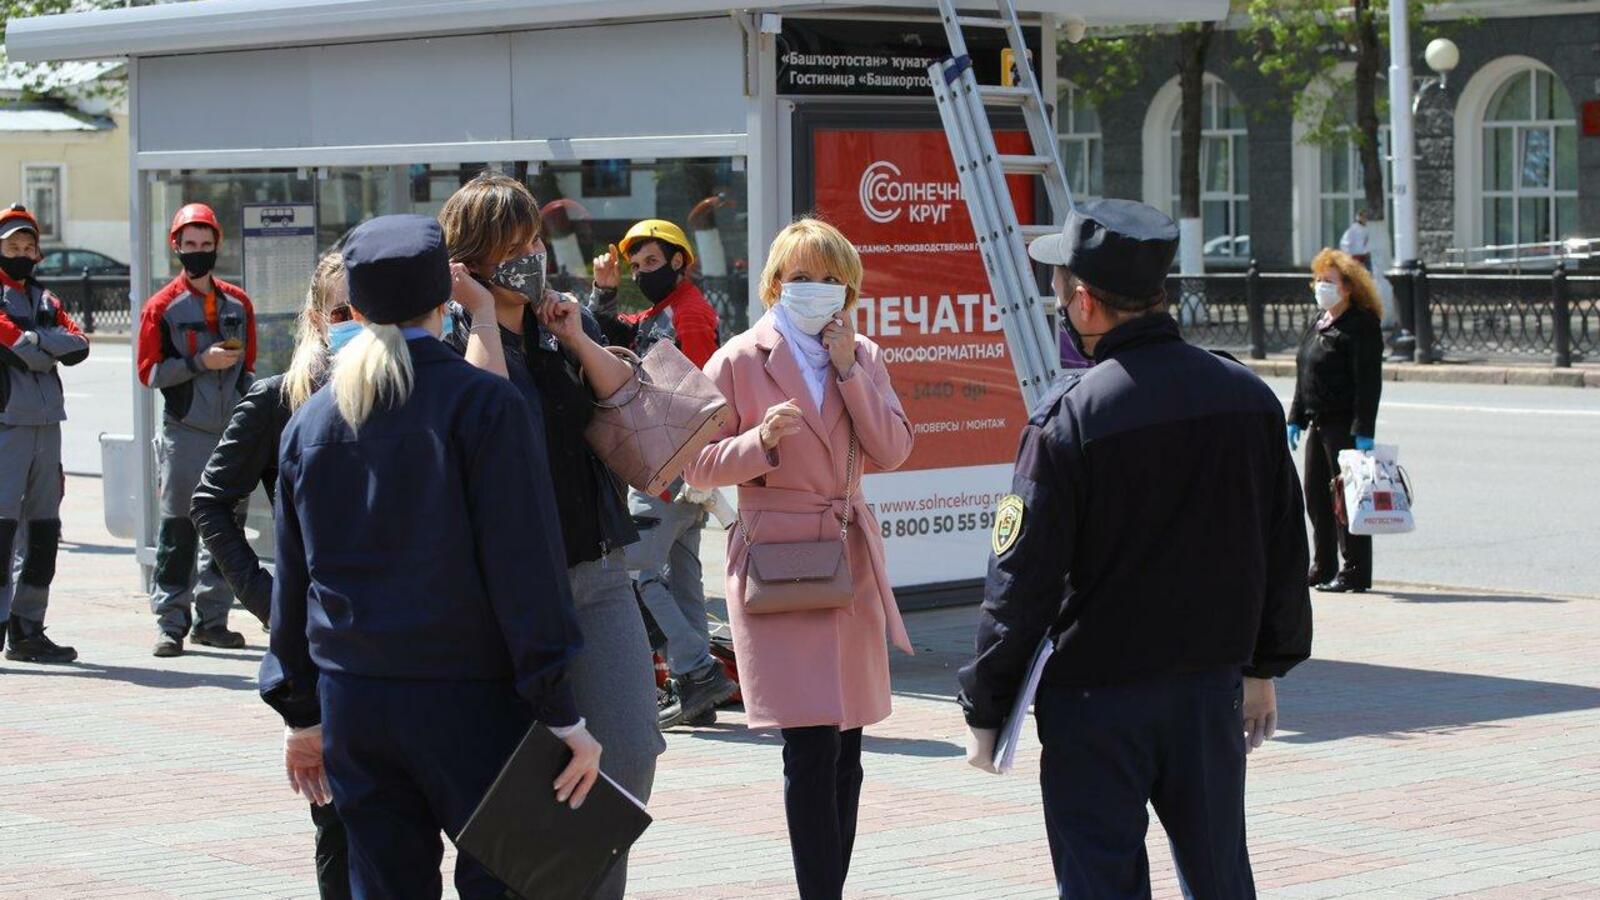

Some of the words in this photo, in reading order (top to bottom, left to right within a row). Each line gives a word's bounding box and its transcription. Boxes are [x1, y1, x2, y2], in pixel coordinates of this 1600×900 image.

[790, 70, 855, 87] Гостиница
[909, 203, 951, 224] КРУГ
[851, 294, 1003, 336] ПЕЧАТЬ
[880, 343, 1005, 364] ОКОФОРМАТНАЯ
[914, 421, 960, 434] ЛЮВЕРСЫ
[966, 418, 1006, 430] МОНТАЖ
[881, 521, 891, 538] 8
[896, 517, 929, 537] 800
[933, 515, 953, 533] 50
[958, 513, 976, 531] 55
